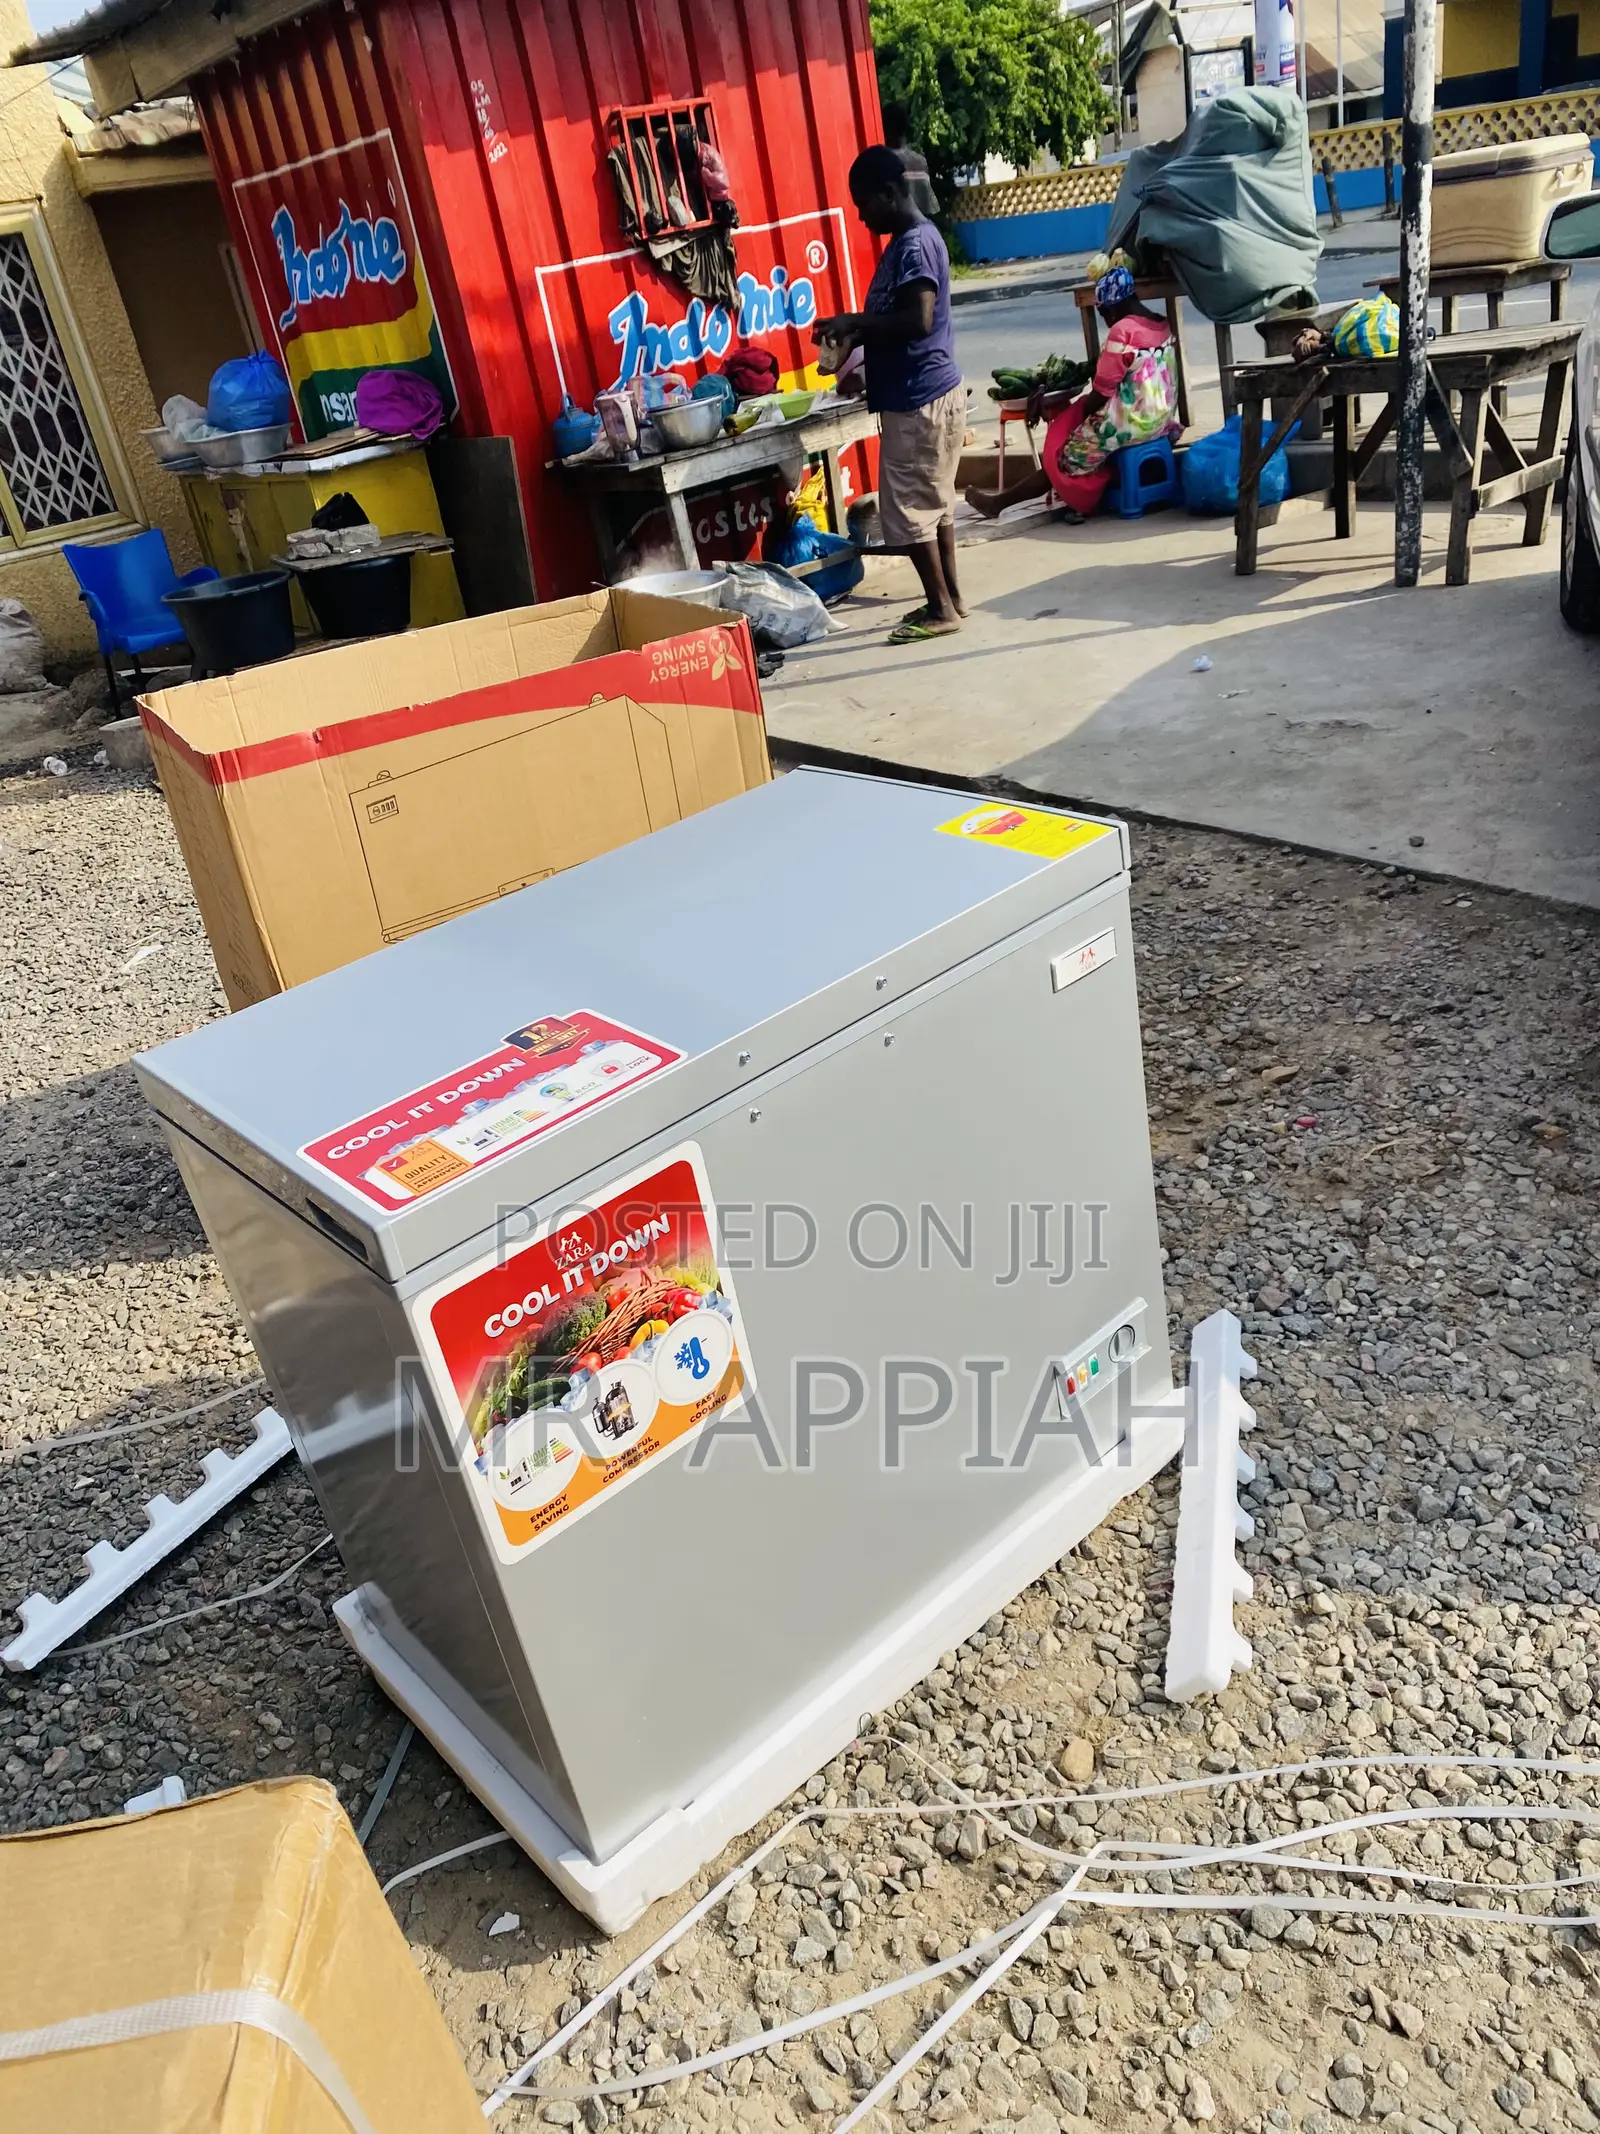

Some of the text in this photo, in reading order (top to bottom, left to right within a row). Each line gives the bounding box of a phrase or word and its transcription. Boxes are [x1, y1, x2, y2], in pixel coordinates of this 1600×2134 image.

[608, 265, 817, 391] Indomie
[652, 640, 706, 665] SAVING
[649, 656, 709, 684] ENERGY
[520, 1023, 549, 1043] 12
[326, 1057, 527, 1160] COOL IT DOWN
[404, 1154, 448, 1180] QUALITY
[416, 1162, 464, 1188] APPROVED
[554, 1242, 593, 1271] ZARA
[484, 1213, 672, 1338] COOL IT DOWN
[690, 1394, 727, 1423] COOLING
[695, 1391, 716, 1409] FAST
[602, 1441, 660, 1484] COMPRESSOR
[605, 1436, 654, 1472] POWERFUL
[529, 1494, 567, 1524] ENERGY
[534, 1504, 570, 1532] SAVING
